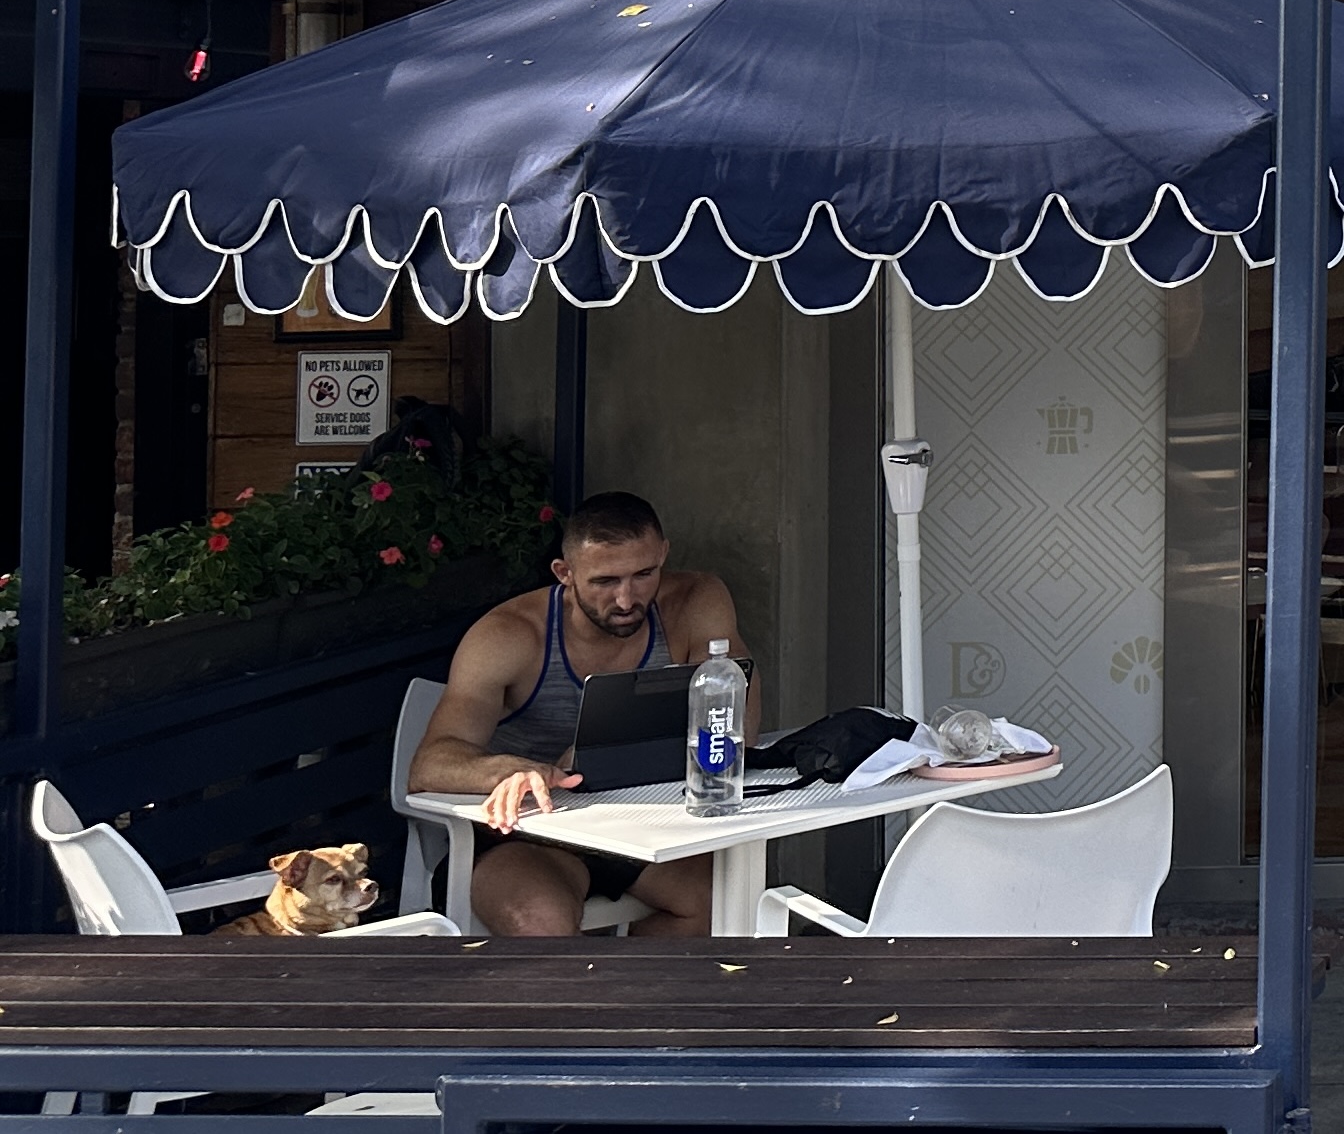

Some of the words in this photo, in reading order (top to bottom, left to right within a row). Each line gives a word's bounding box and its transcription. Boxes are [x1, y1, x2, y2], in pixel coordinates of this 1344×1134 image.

[305, 360, 318, 372] NO
[320, 360, 340, 372] PETS
[342, 360, 384, 372] ALLOWED
[315, 412, 348, 423] SERVICE
[350, 412, 371, 423] DOGS
[314, 426, 330, 436] ARE
[332, 424, 372, 436] WELCOME
[708, 707, 726, 765] smart
